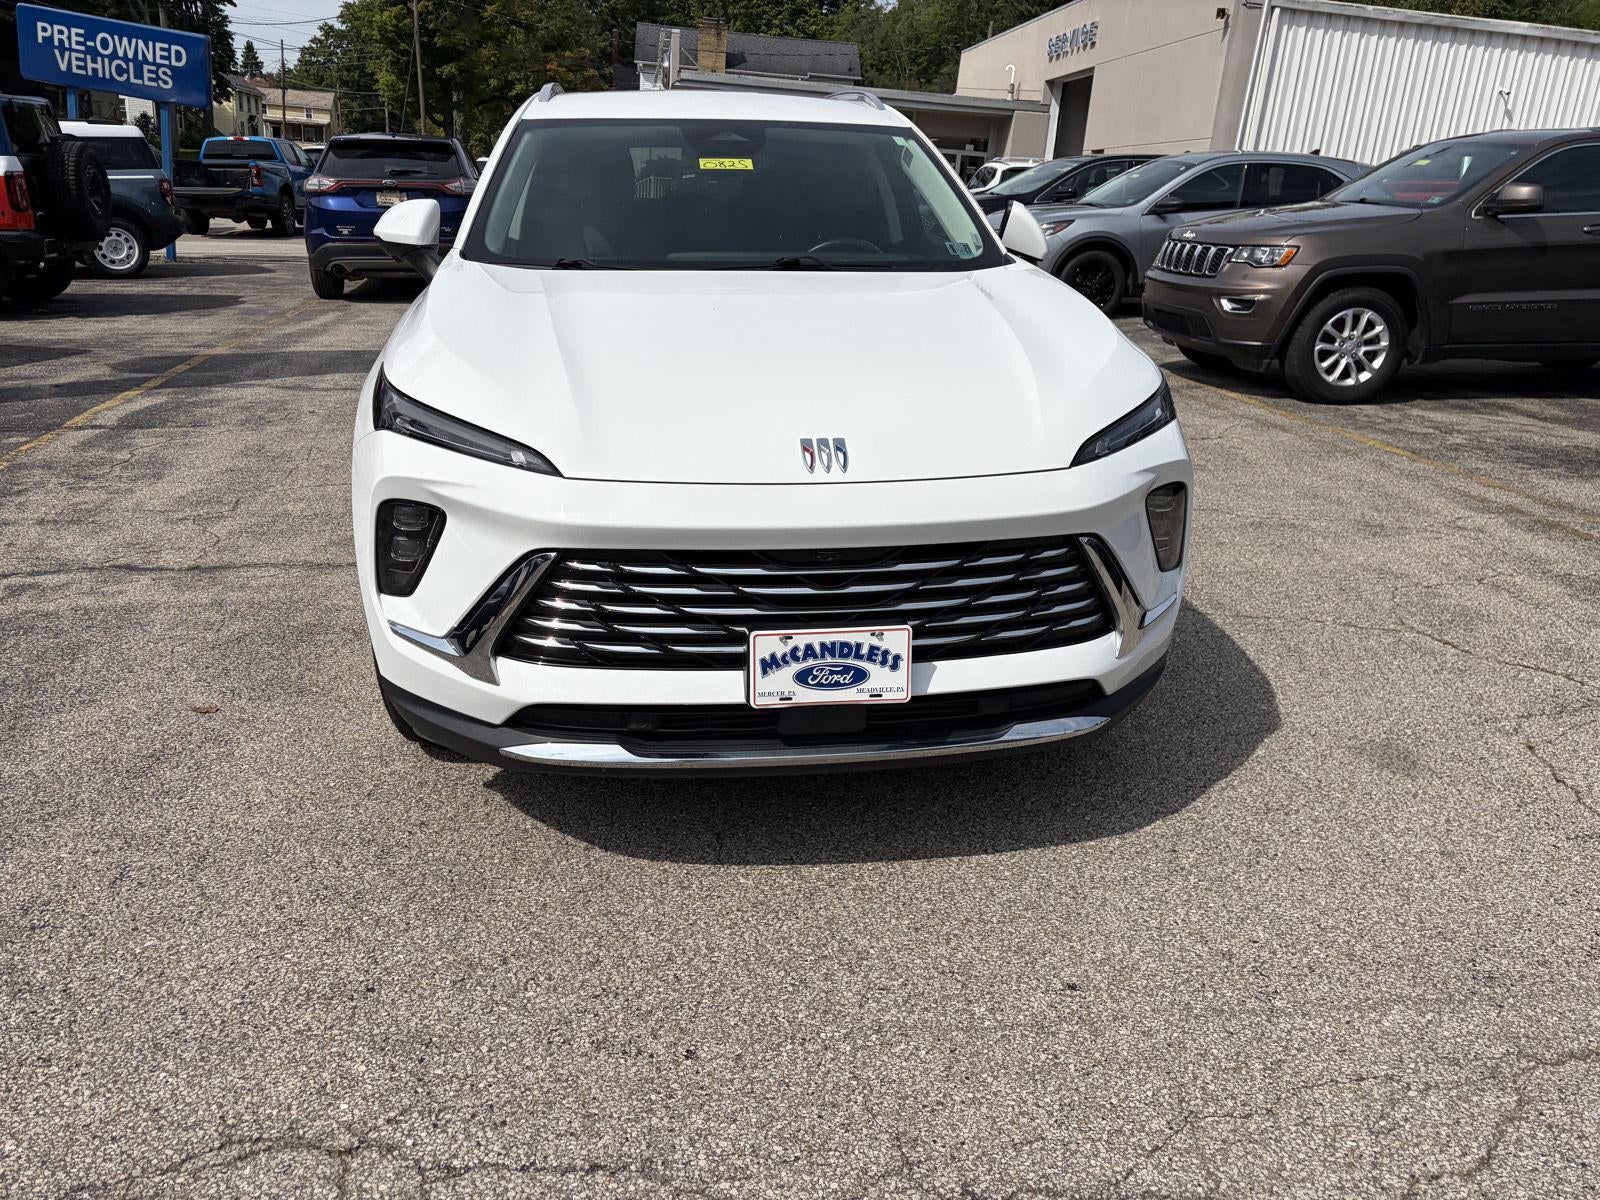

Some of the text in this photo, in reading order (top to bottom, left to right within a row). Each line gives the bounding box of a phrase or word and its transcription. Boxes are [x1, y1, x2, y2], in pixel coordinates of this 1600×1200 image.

[36, 21, 187, 67] PRE-OWNED
[1047, 21, 1099, 57] SERVICE
[53, 49, 173, 89] VEHICLES
[807, 665, 855, 685] Ford
[856, 686, 896, 694] MEADVILLE,
